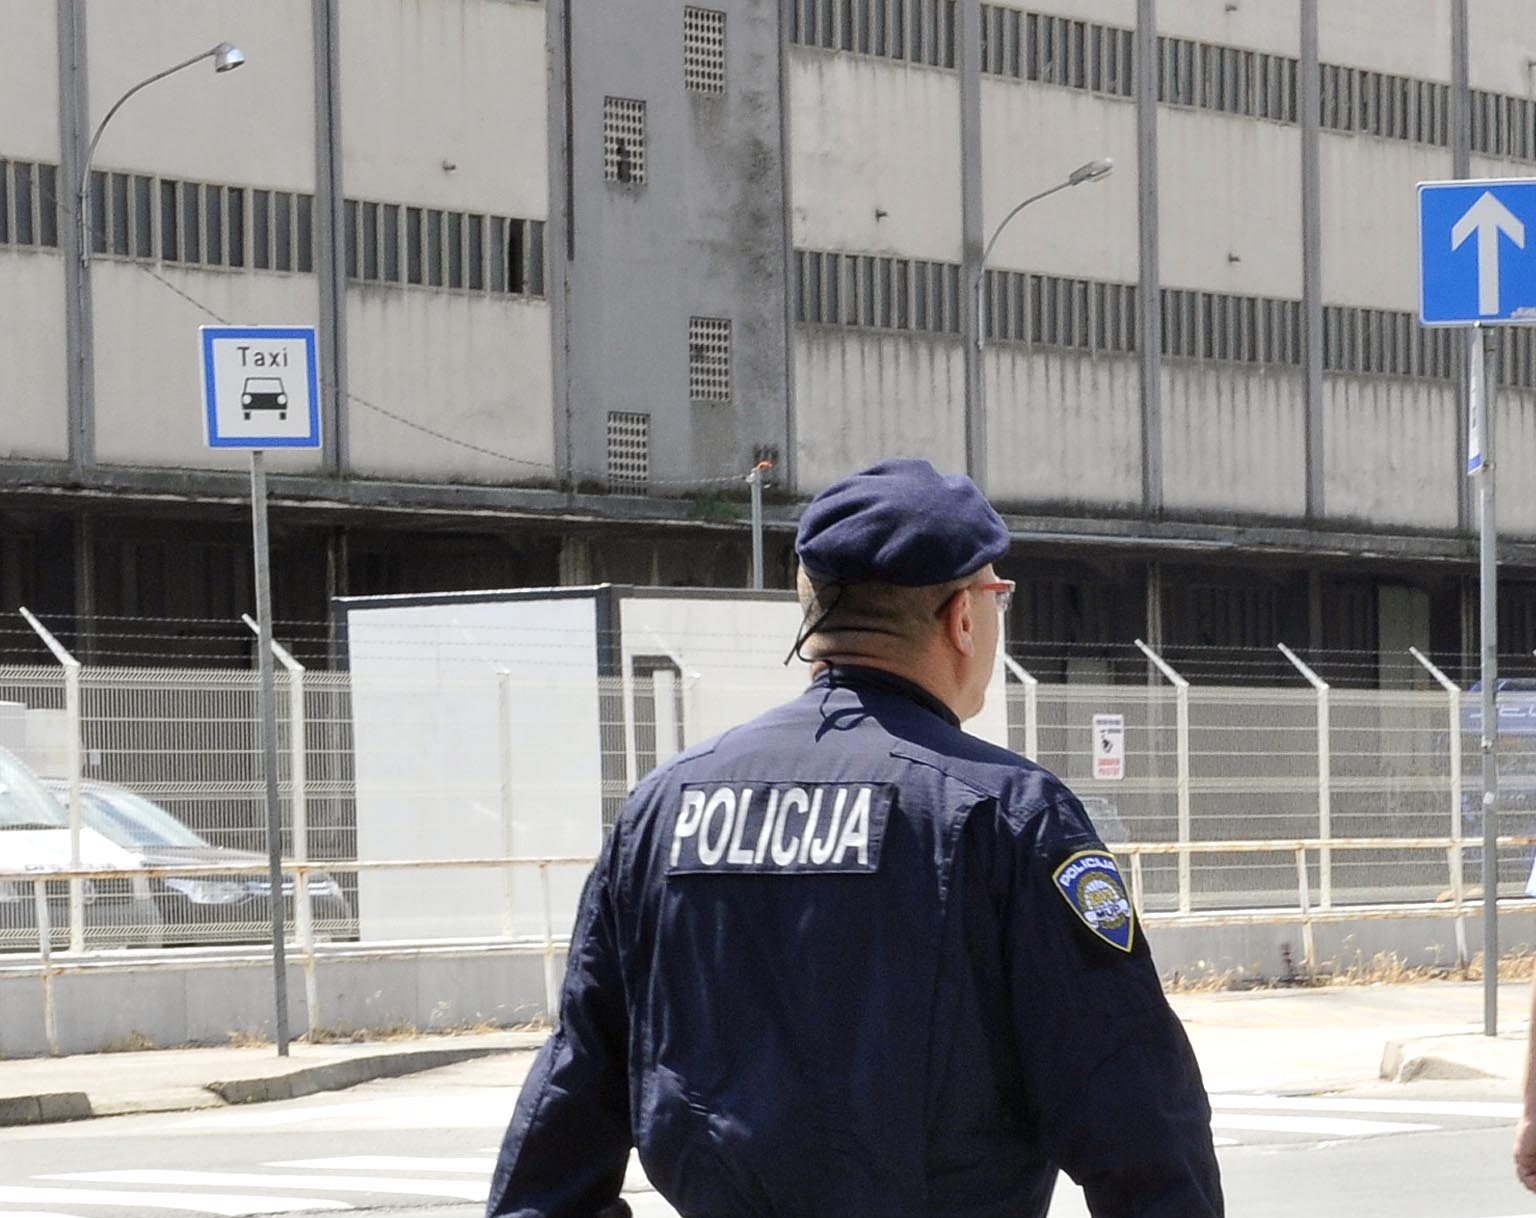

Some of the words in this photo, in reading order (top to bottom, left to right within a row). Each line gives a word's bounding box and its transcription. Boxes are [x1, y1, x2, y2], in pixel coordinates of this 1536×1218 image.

[237, 346, 288, 367] Taxi
[670, 787, 872, 867] POLICIJA
[1059, 857, 1117, 887] POLICIJA
